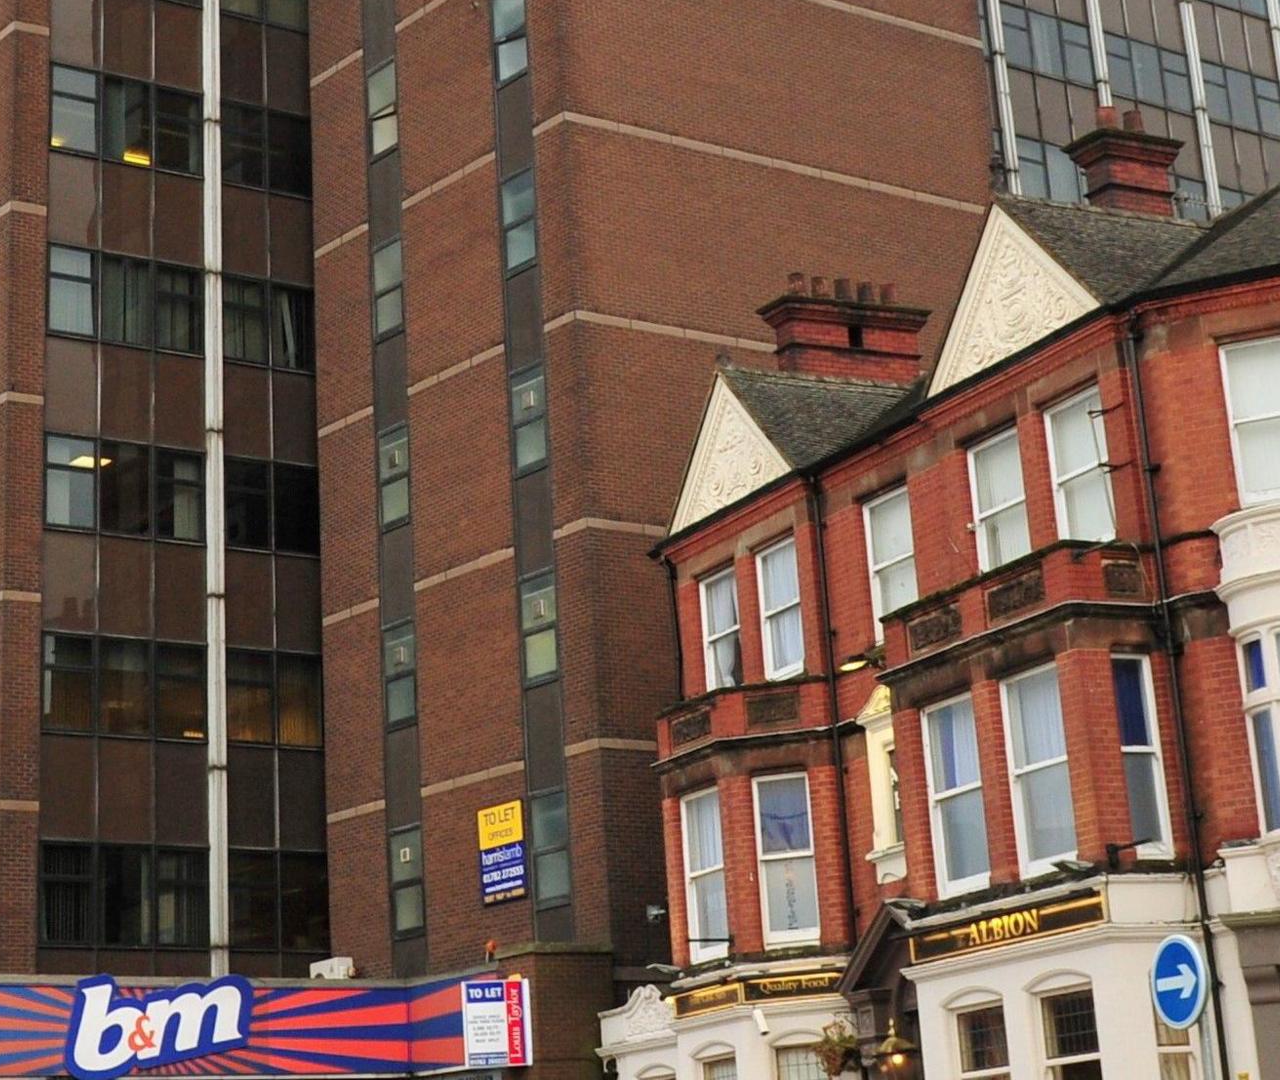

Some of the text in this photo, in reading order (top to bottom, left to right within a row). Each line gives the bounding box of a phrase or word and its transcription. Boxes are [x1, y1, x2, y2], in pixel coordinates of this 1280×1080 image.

[483, 807, 515, 826] TO LET
[969, 909, 1040, 945] ALBION
[468, 987, 502, 999] TO LET
[760, 977, 830, 994] Quality Food
[73, 983, 243, 1071] b&m
[508, 988, 523, 1058] Louis Taylor
